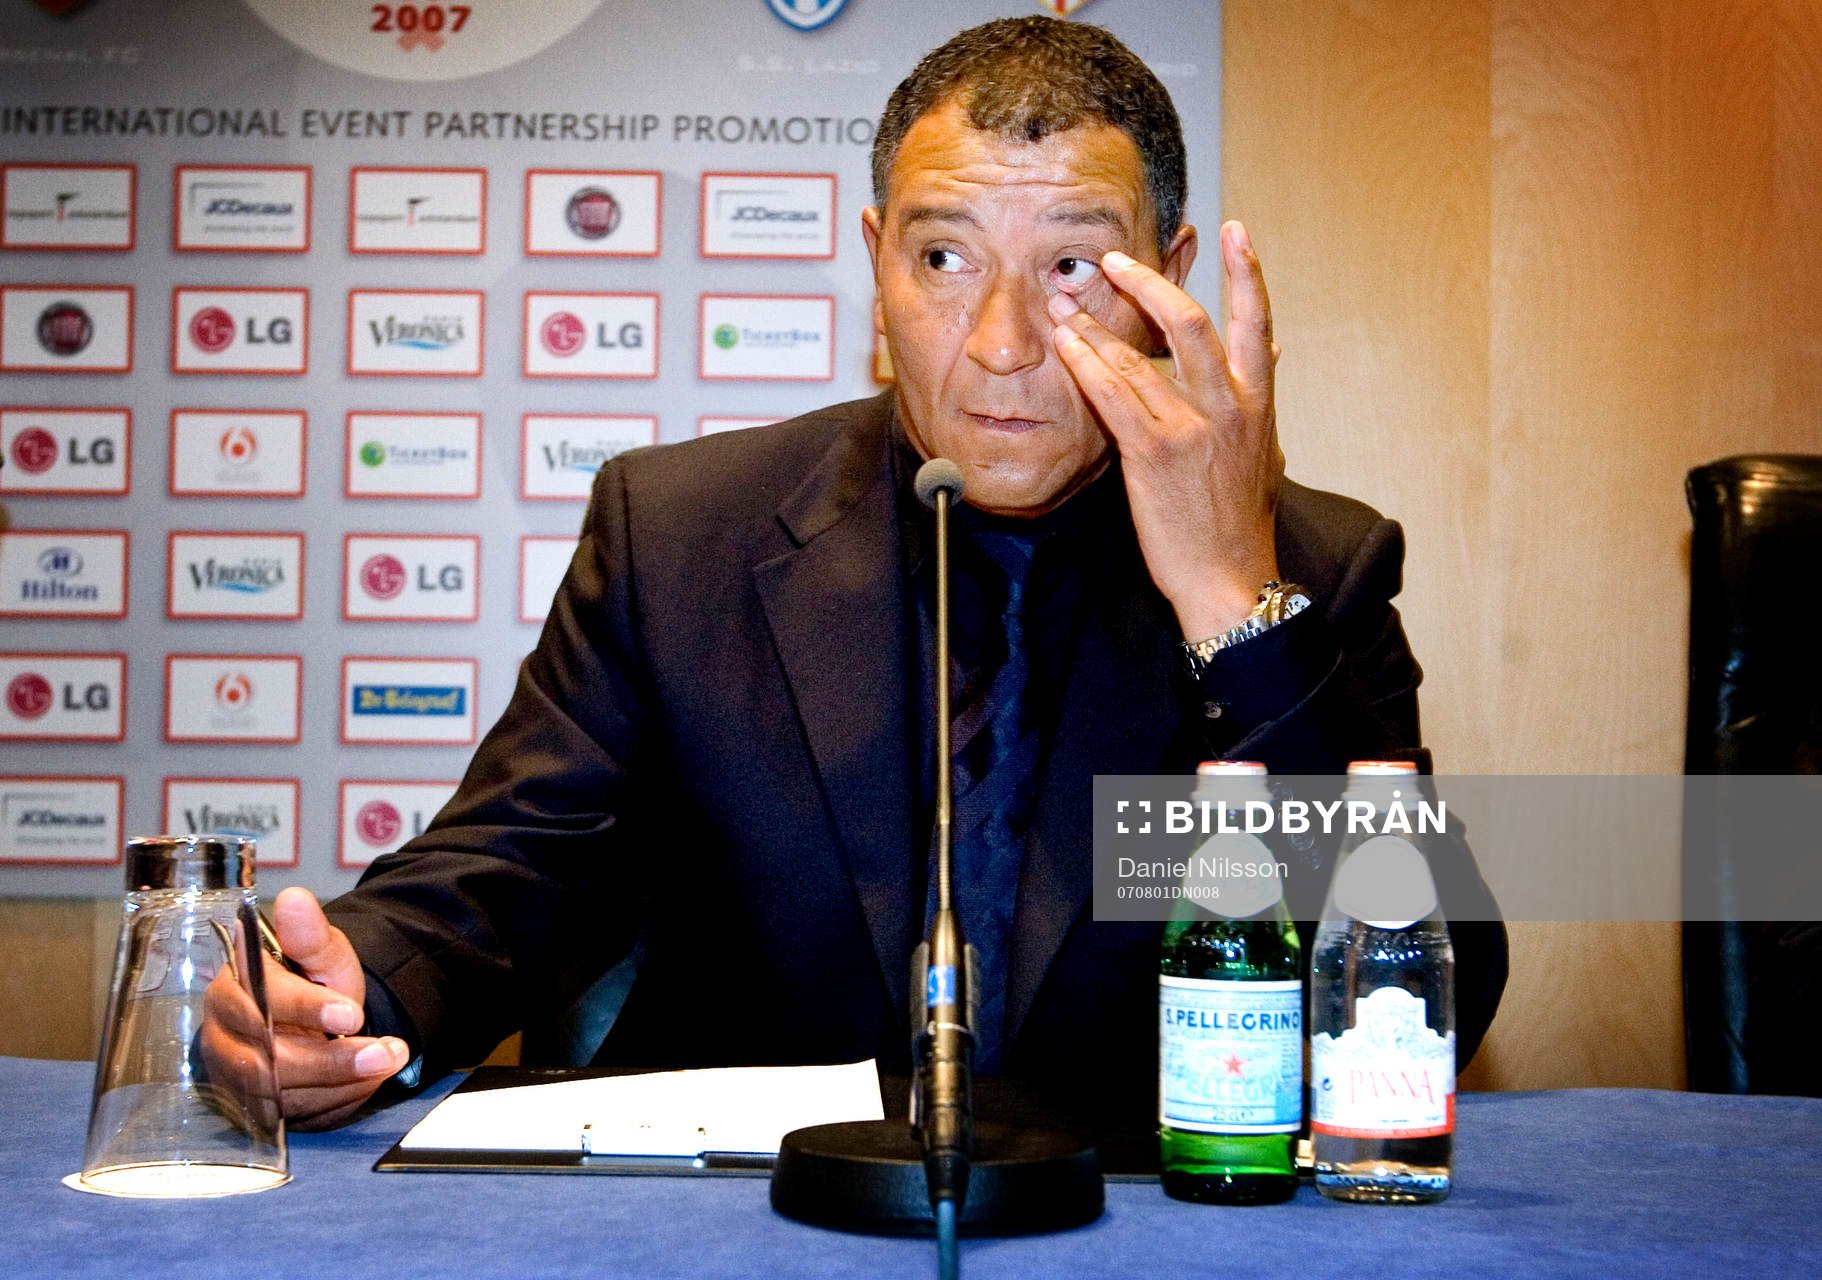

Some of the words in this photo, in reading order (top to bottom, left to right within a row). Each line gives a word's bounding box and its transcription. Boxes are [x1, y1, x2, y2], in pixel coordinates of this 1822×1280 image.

[371, 5, 472, 33] 2007
[1, 105, 286, 138] INTERNATIONAL
[302, 109, 411, 138] EVENT
[424, 110, 660, 141] PARTNERSHIP
[674, 114, 877, 144] PROMOTIO
[246, 317, 292, 344] LG
[596, 322, 643, 348] LG
[68, 437, 115, 464] LG
[21, 579, 98, 600] Hilton
[417, 564, 464, 591] LG
[62, 683, 110, 711] LG
